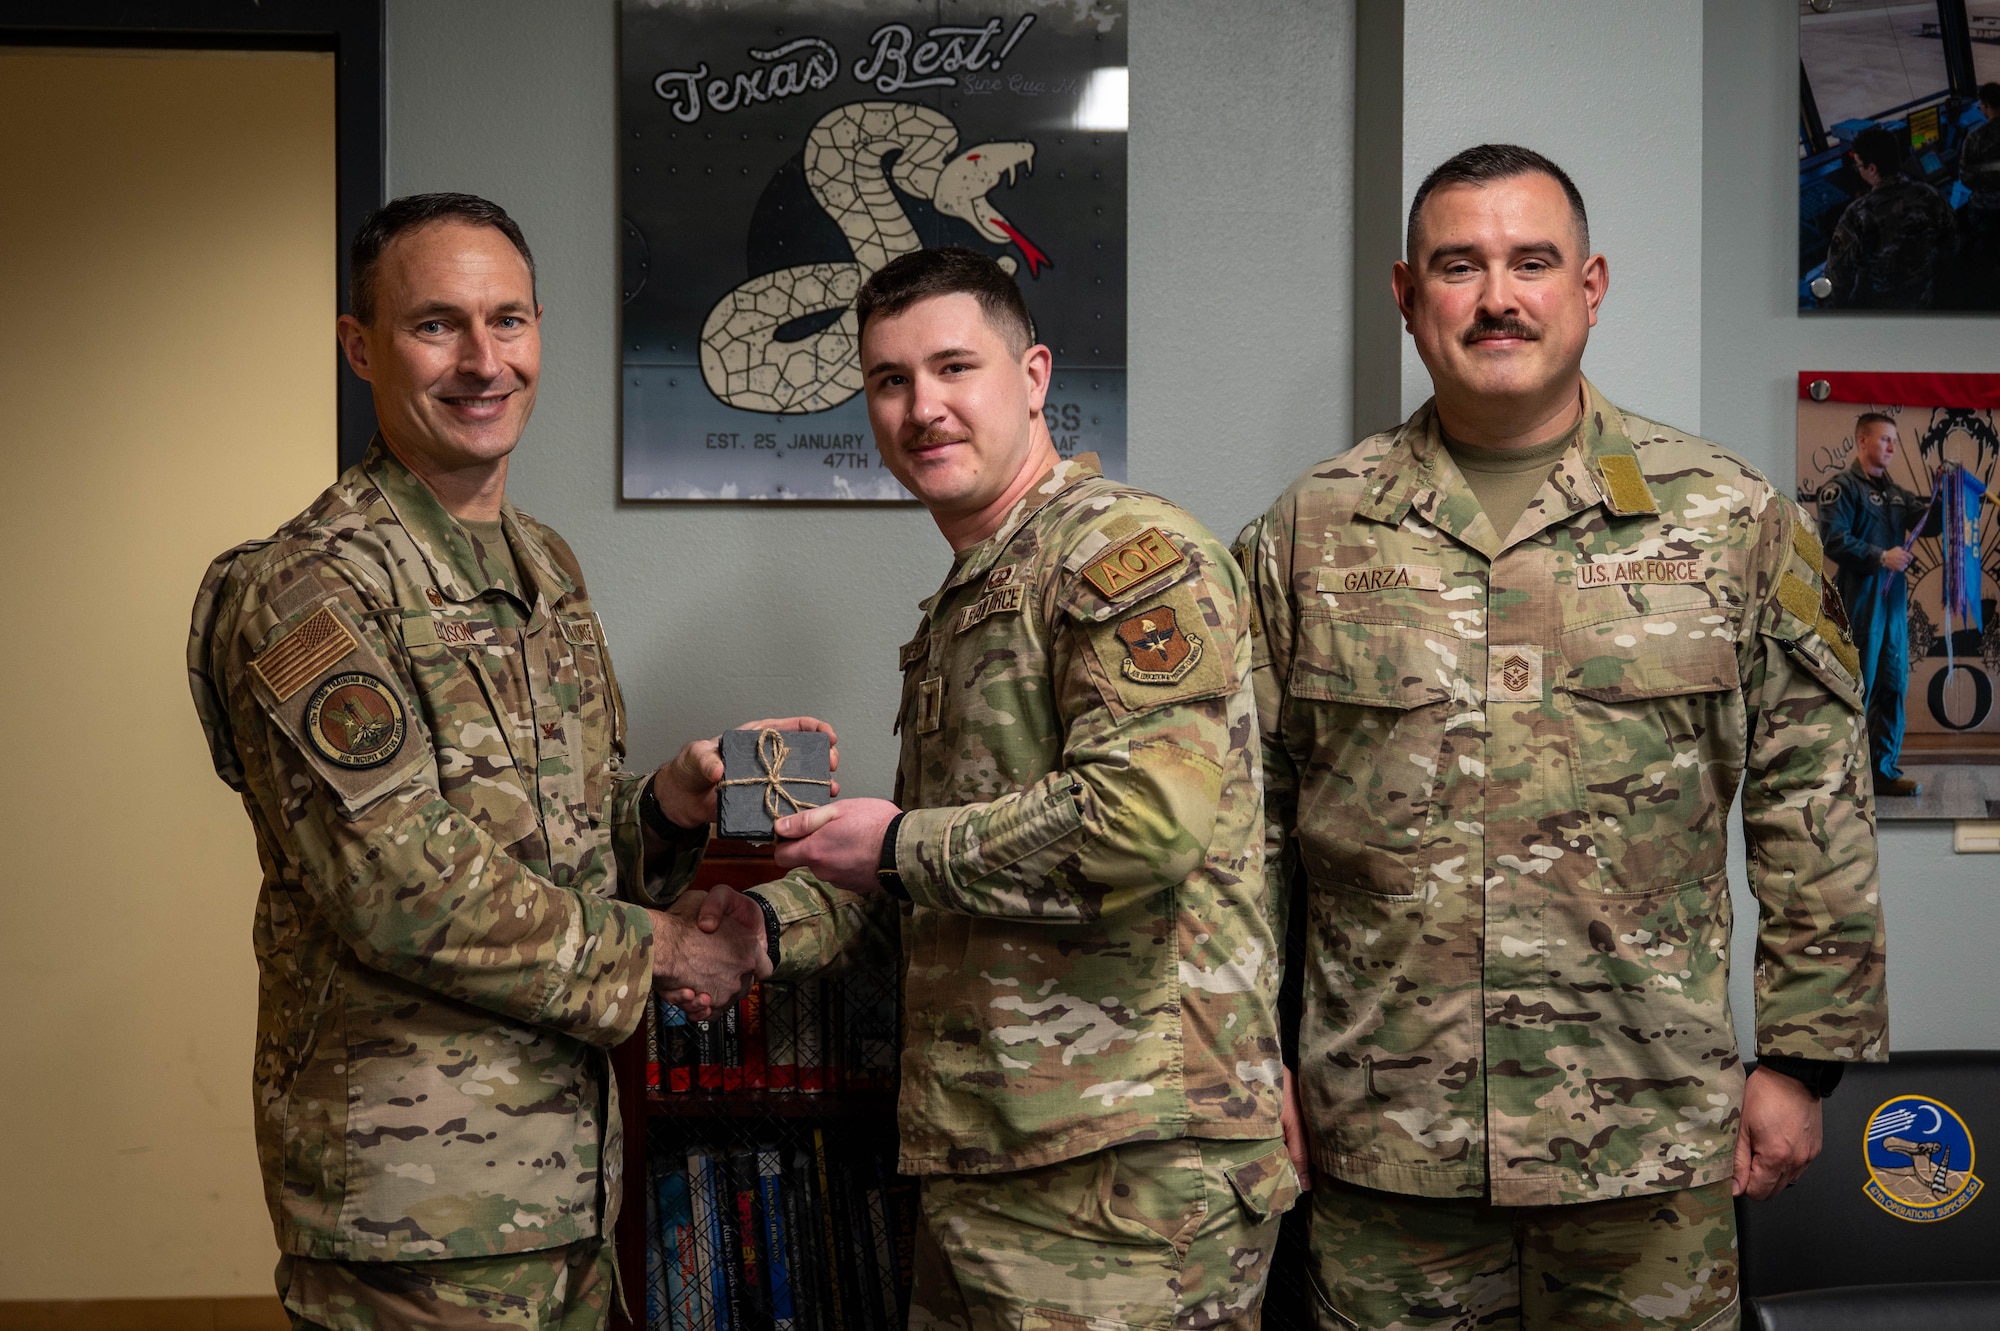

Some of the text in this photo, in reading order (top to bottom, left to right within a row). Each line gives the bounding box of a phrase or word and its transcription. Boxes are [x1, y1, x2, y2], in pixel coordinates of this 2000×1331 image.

[655, 15, 1037, 122] Texas Best!
[1006, 73, 1047, 96] Qua
[706, 433, 745, 449] EST.
[754, 433, 776, 449] 25
[787, 433, 865, 449] JANUARY
[823, 453, 868, 469] 47TH
[1812, 435, 1855, 474] Qua
[1100, 535, 1162, 589] AOF
[1581, 560, 1699, 585] U.S. AIR FORCE
[1344, 567, 1410, 592] GARZA
[312, 687, 329, 710] FLYING
[361, 676, 379, 689] WING
[647, 1000, 657, 1020] WIN
[647, 1031, 658, 1062] WORK
[1885, 1200, 1935, 1219] OPERATIONS
[1935, 1191, 1970, 1217] SUPPORT
